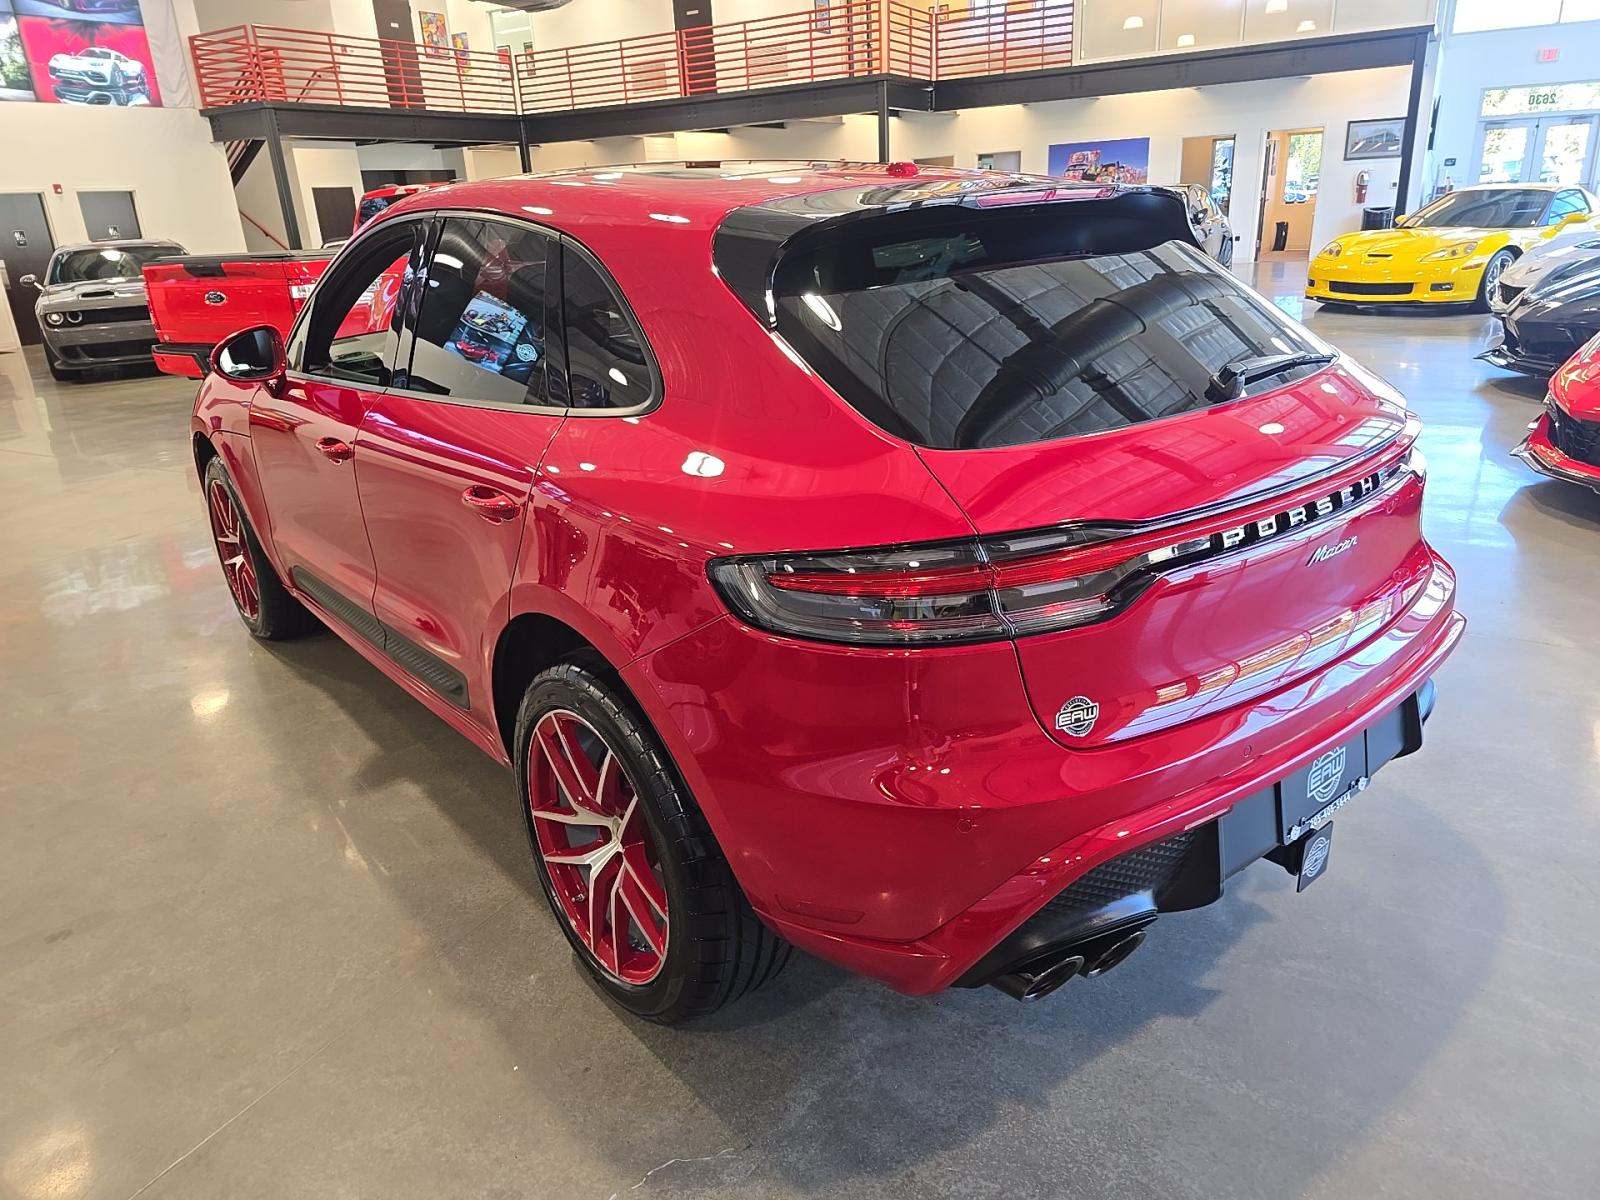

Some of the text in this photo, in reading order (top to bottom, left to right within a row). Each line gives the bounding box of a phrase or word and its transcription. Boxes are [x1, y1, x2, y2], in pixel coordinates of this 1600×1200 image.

[1222, 469, 1389, 548] PORSCHE
[1306, 536, 1357, 567] Macan
[1058, 706, 1097, 727] EAW
[1310, 753, 1343, 791] EAW
